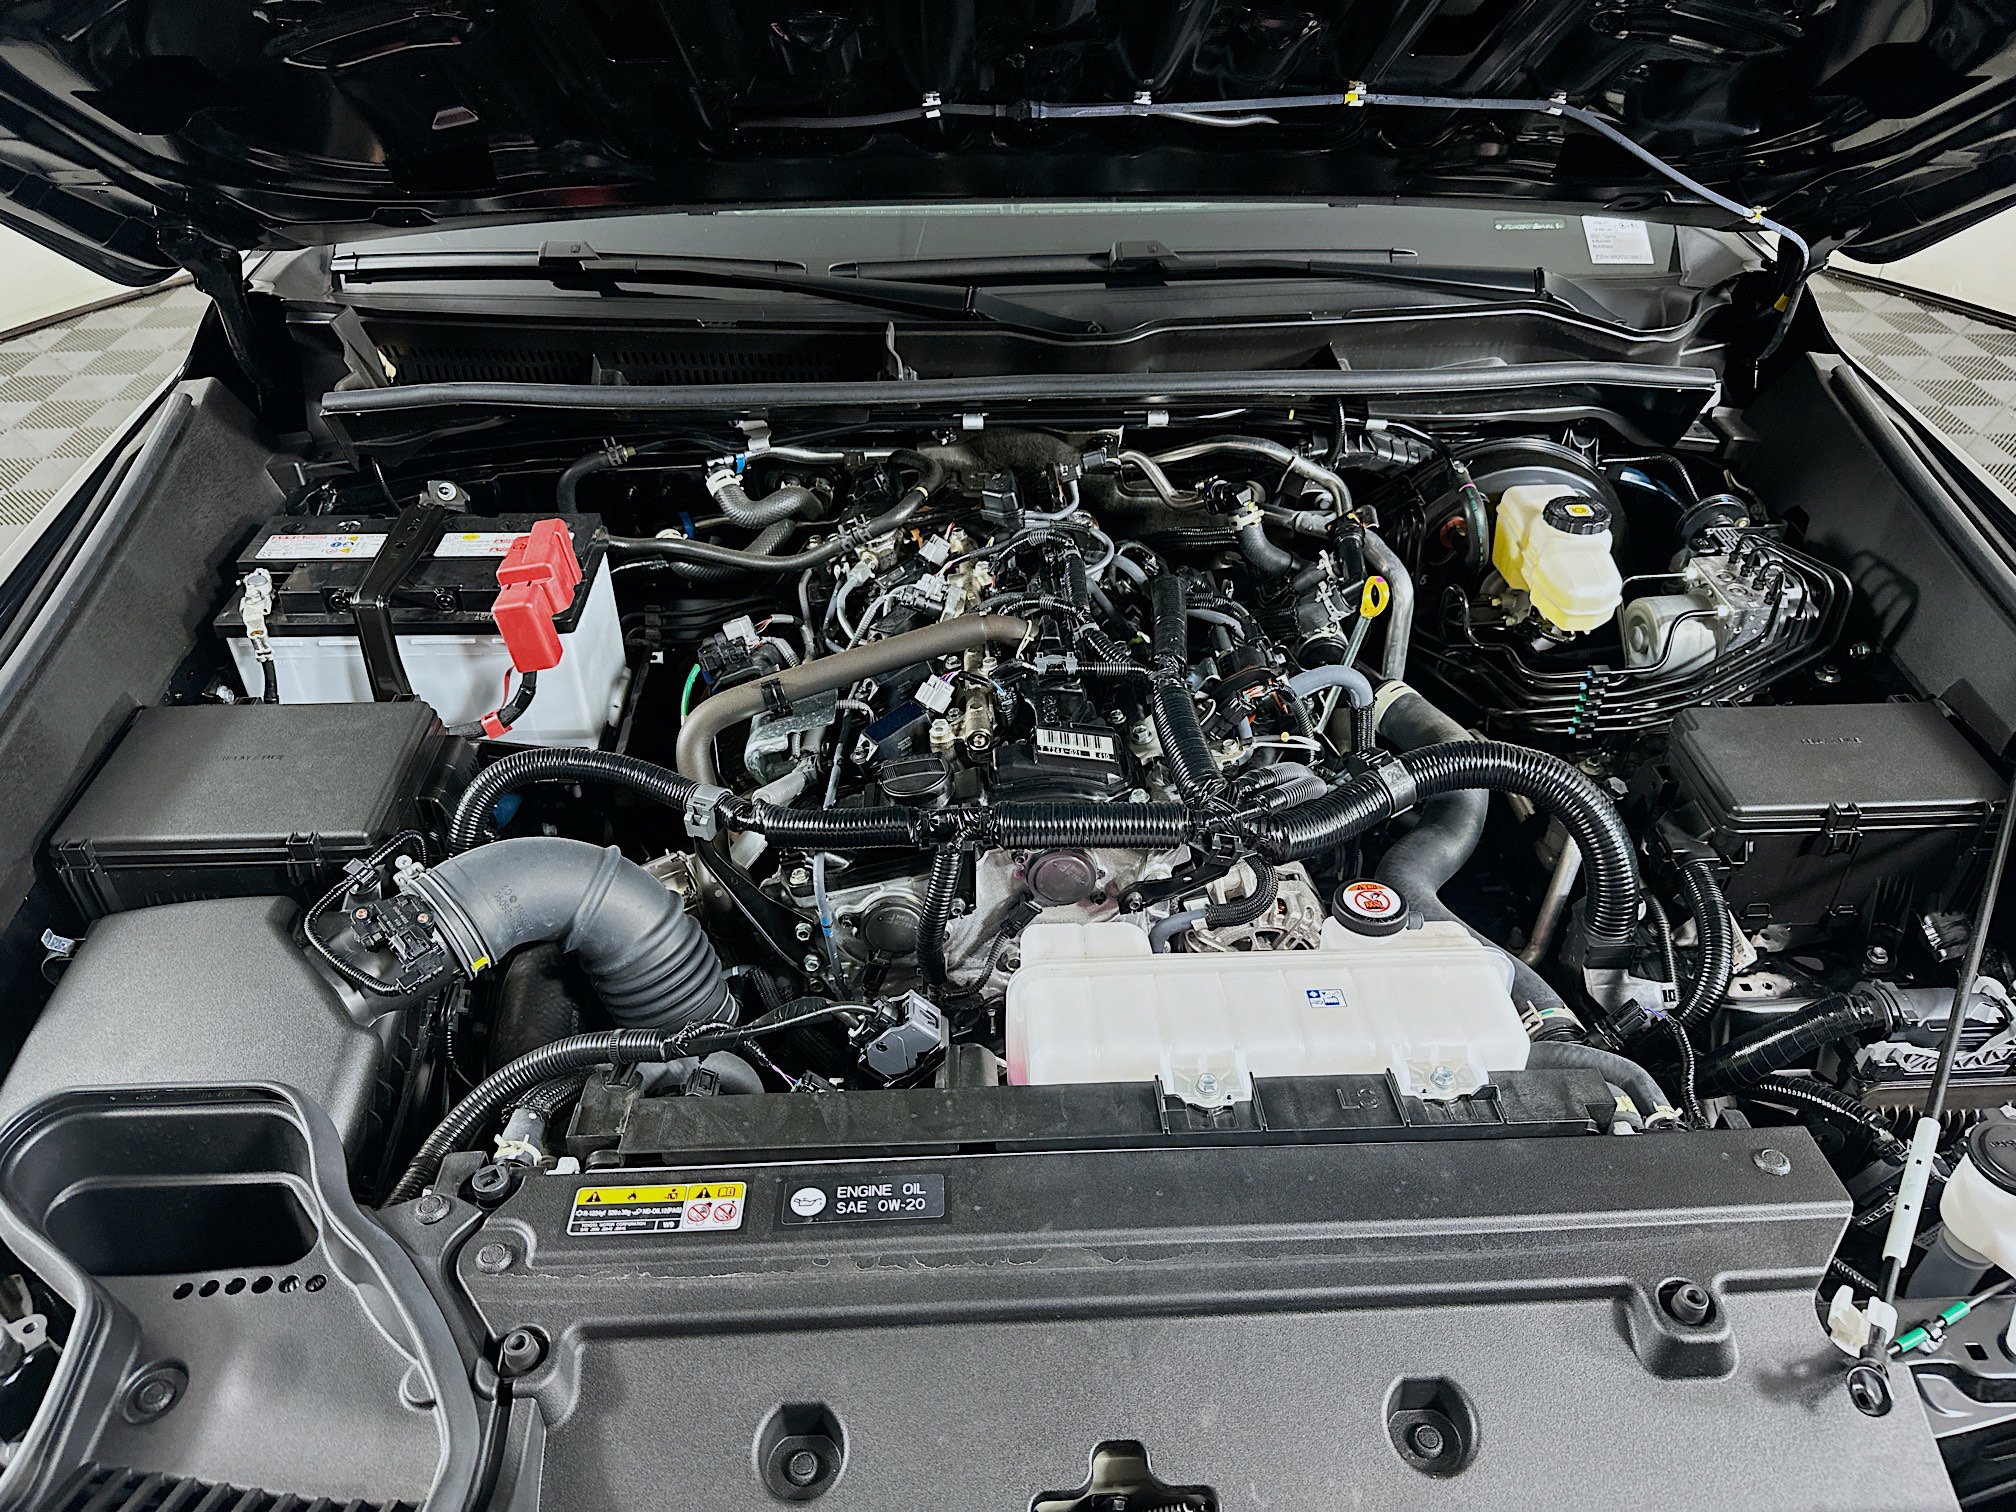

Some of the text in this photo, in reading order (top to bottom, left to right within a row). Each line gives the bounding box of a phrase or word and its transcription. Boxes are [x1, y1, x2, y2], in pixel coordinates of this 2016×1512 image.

[836, 1182, 927, 1199] ENGINE OIL
[835, 1198, 926, 1215] SAE 0W-20
